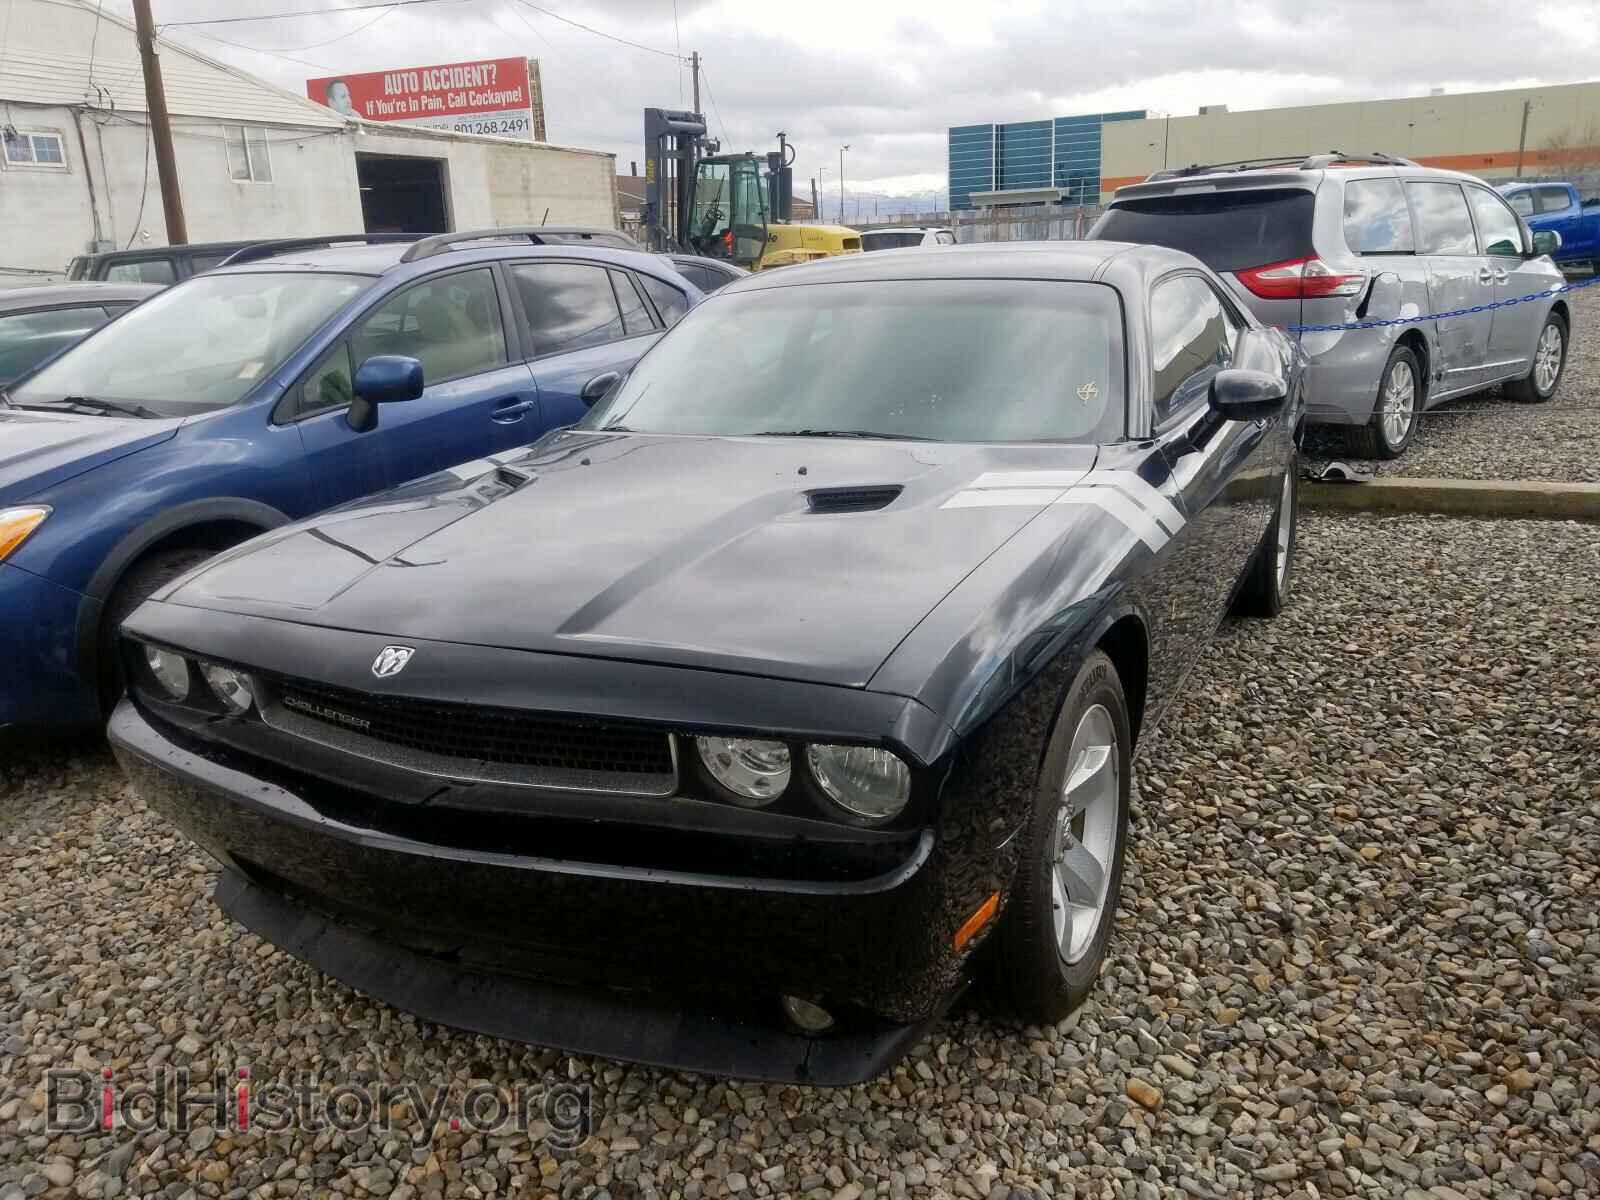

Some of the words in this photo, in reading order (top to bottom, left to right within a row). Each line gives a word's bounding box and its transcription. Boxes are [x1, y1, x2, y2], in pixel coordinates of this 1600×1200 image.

[384, 71, 419, 95] AUTO
[422, 64, 497, 92] ACCIDENT?
[366, 99, 374, 116] If
[376, 98, 407, 114] You're
[408, 97, 418, 112] In
[421, 94, 446, 111] Pain,
[448, 92, 467, 108] Call
[469, 86, 523, 109] Cockayne!
